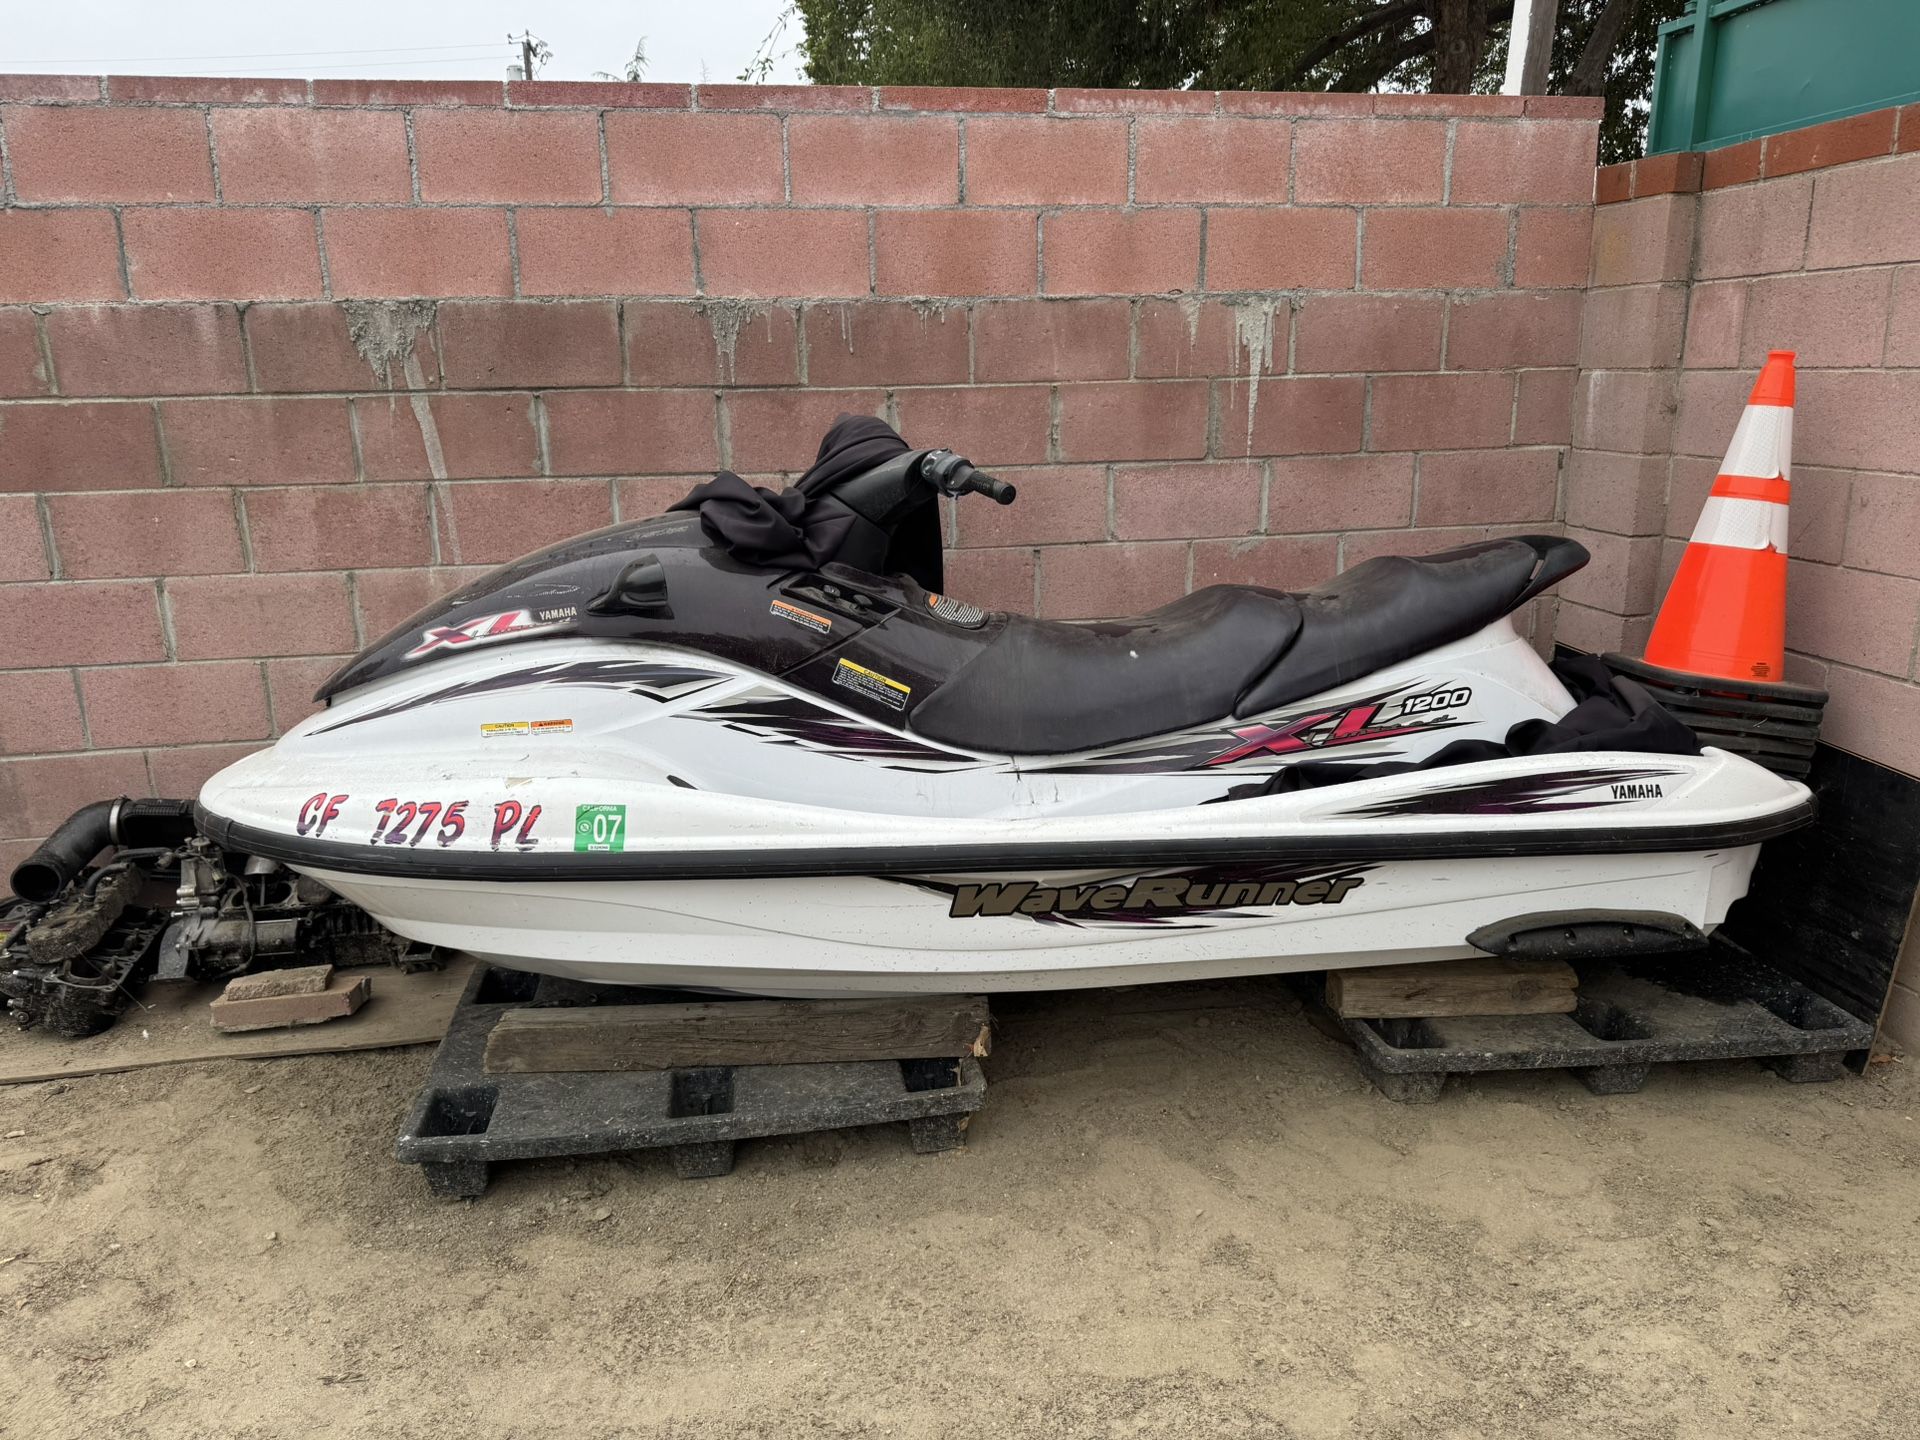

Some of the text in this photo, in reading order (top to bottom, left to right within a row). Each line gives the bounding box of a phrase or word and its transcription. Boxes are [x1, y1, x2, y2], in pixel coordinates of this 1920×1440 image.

[539, 606, 577, 622] YAMAHA
[404, 609, 528, 659] XL
[863, 669, 888, 684] CAUTION
[1400, 686, 1472, 715] 1200
[1202, 703, 1412, 767] XL
[1610, 784, 1663, 799] YAMAHA
[296, 792, 349, 838] CF
[489, 800, 542, 852] PL
[593, 813, 622, 843] 07
[948, 876, 1364, 918] WaveRunner
